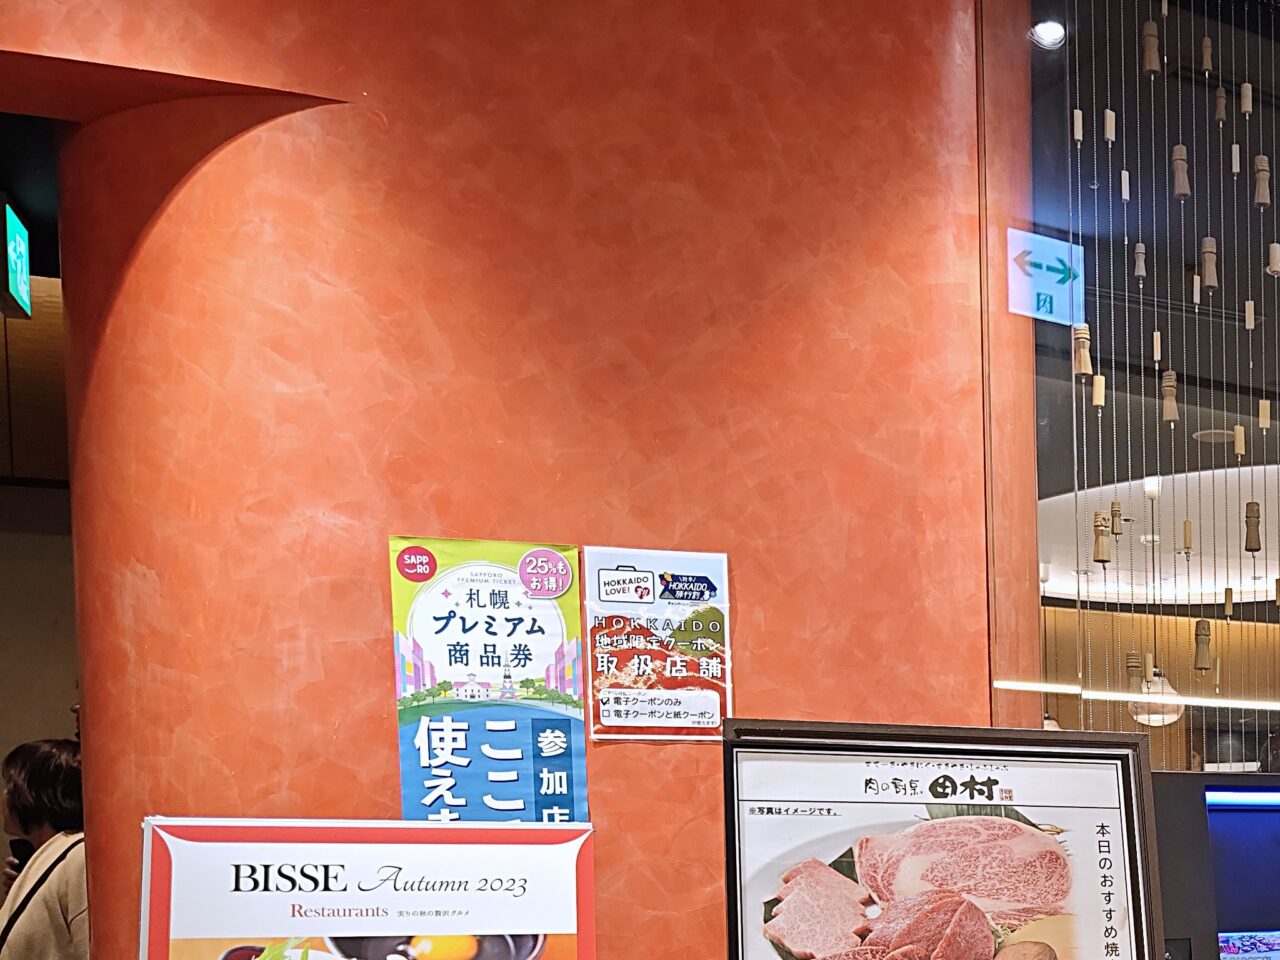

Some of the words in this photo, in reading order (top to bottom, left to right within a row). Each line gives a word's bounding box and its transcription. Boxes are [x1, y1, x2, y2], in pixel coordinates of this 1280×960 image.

[404, 555, 429, 564] SAPP
[526, 557, 567, 574] 25%も
[604, 576, 649, 588] HOKKAIDO
[668, 582, 708, 590] HOKKAIDO
[466, 588, 510, 610] 札幌
[606, 587, 630, 596] LOVE!
[432, 610, 546, 637] プレミアム
[594, 616, 720, 632] HOKKAIDO
[595, 634, 720, 652] 地域限定クーポン
[446, 642, 533, 668] 商品券
[596, 654, 722, 678] 取扱店舗
[613, 697, 682, 706] 電子クーポンのみ
[613, 710, 715, 720] 電子クーポンと紙クーポン
[928, 774, 1000, 801] 田村
[230, 864, 348, 892] BISSE
[357, 865, 470, 892] Autumn
[475, 878, 528, 898] 2023
[290, 904, 389, 918] Restaurants
